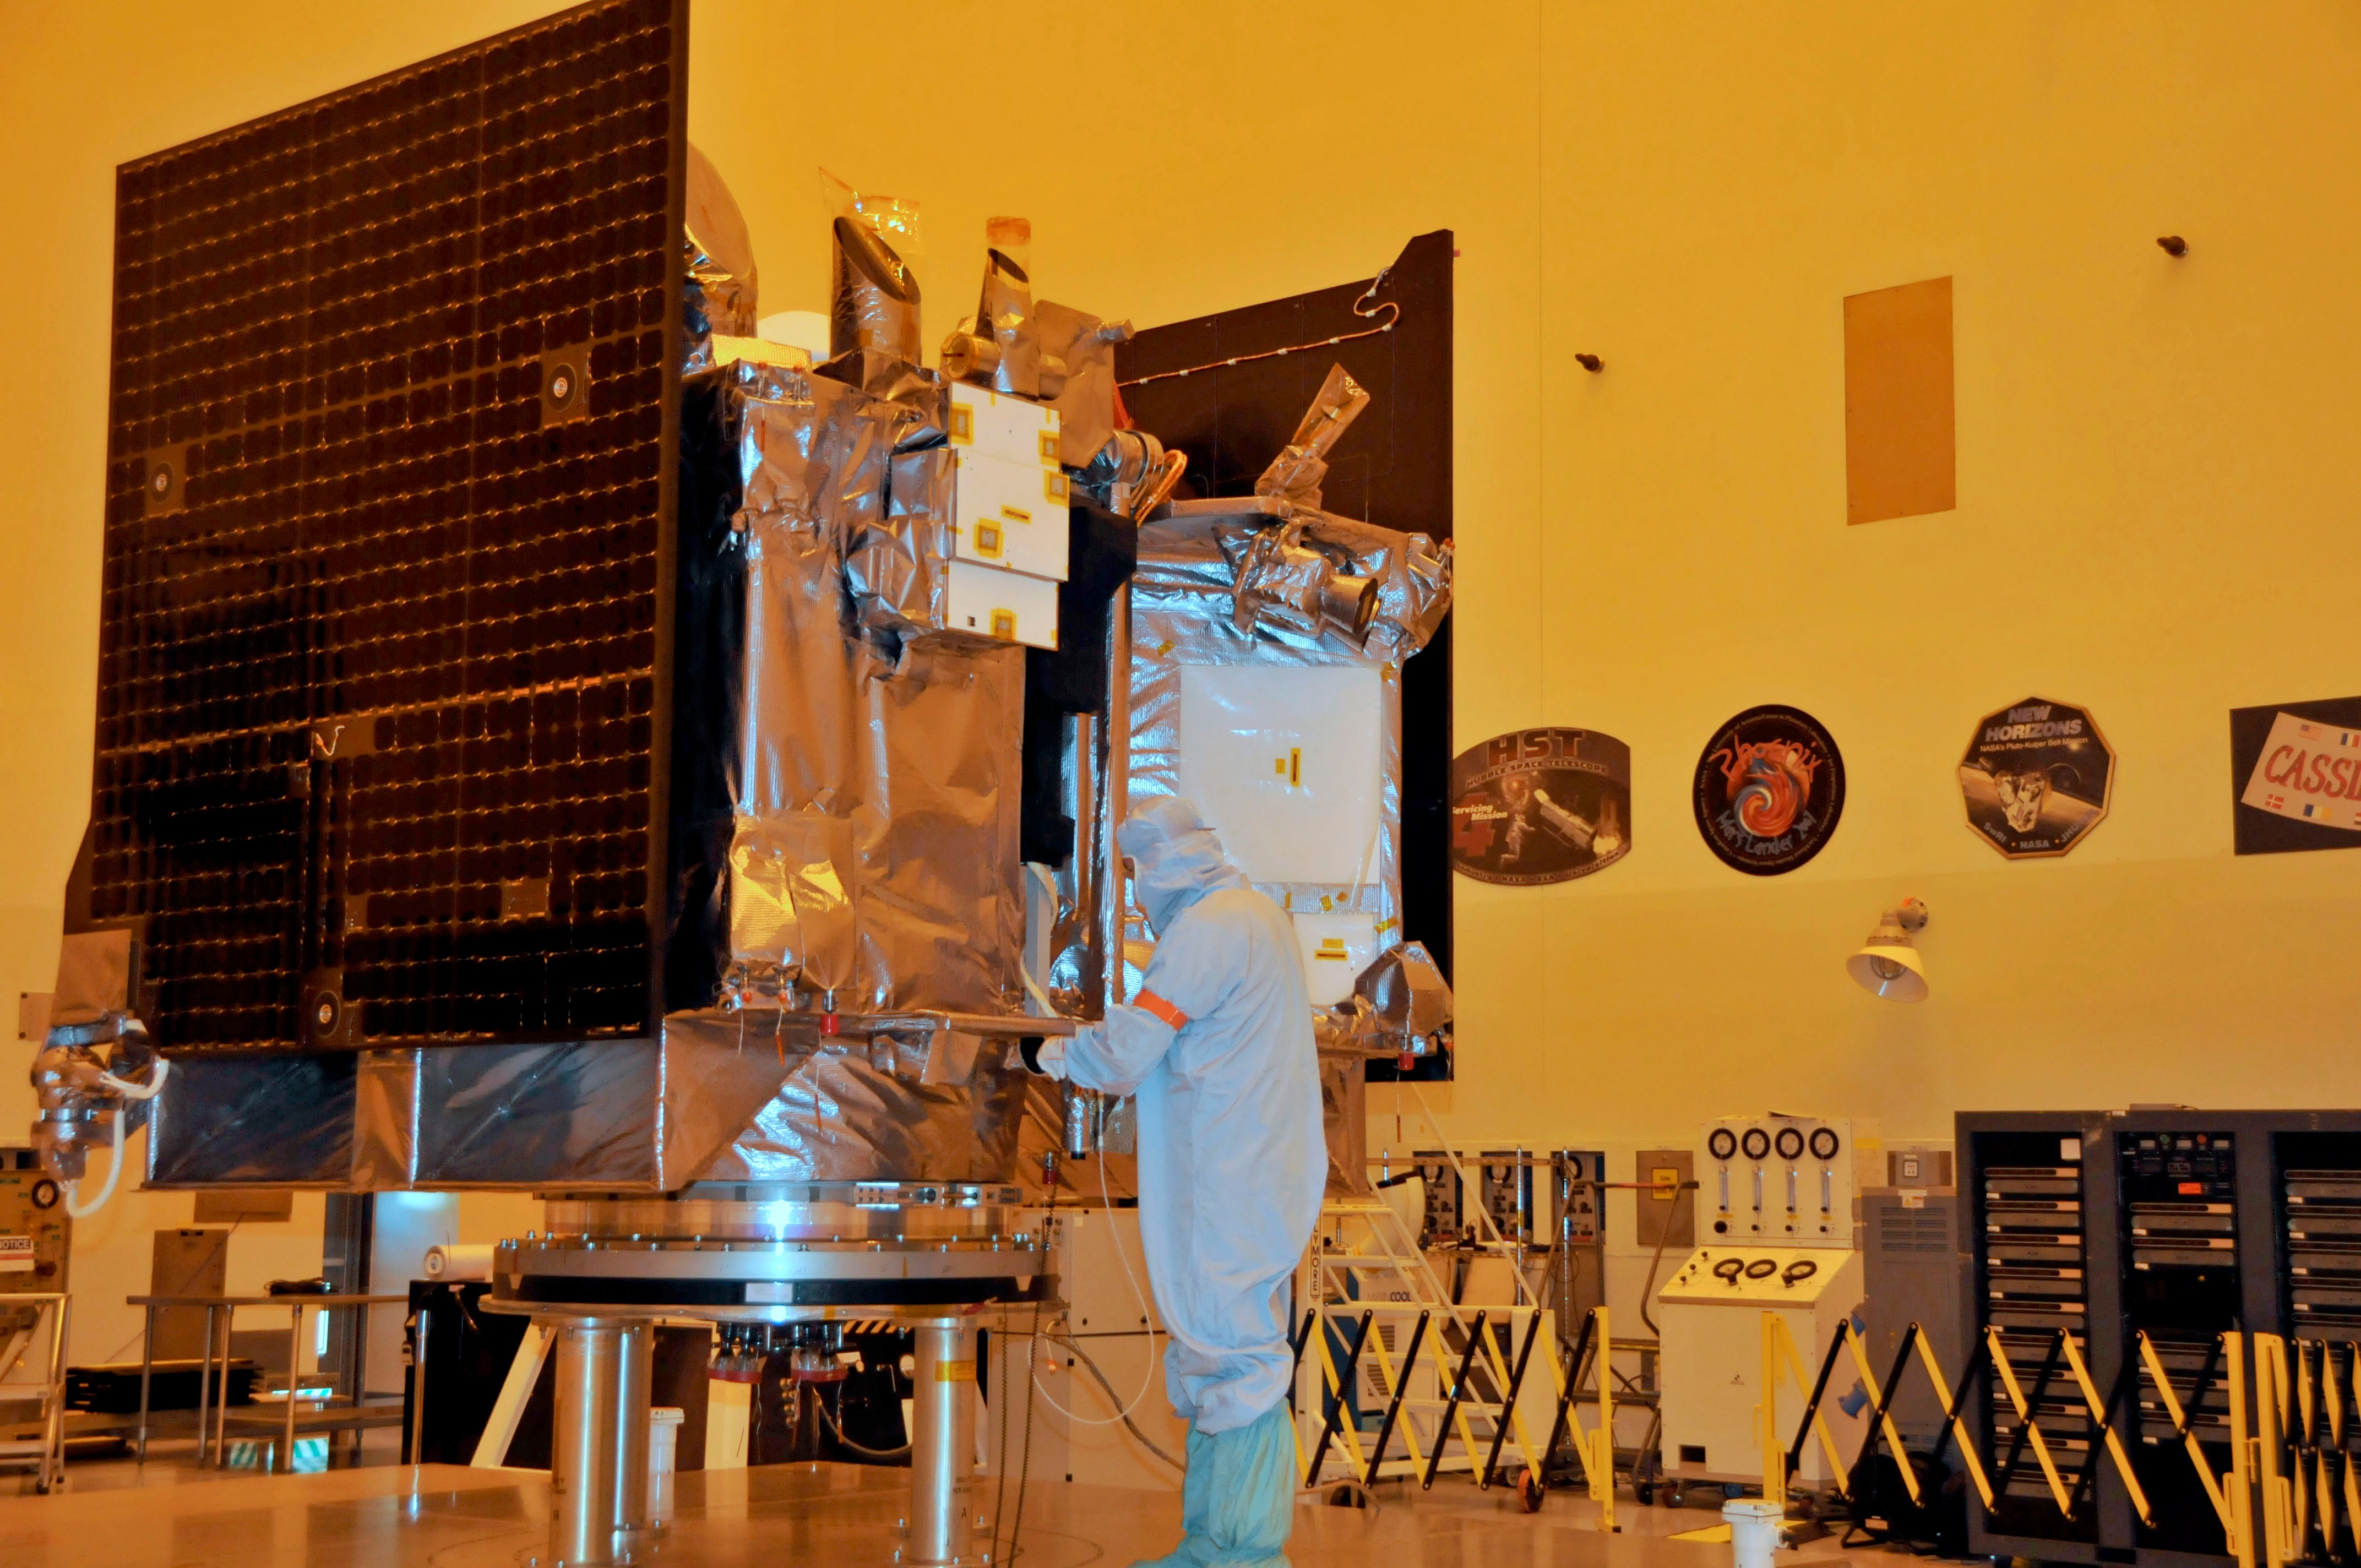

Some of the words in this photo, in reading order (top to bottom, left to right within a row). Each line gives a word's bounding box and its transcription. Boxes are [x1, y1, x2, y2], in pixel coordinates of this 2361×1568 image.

[2008, 706, 2051, 723] NEW
[1985, 719, 2082, 742] HORIZONS
[1487, 728, 1584, 767] HST
[1980, 744, 2005, 752] NASA's
[2006, 741, 2046, 750] Pluto-Kuiper
[1709, 734, 1823, 783] Phoenix
[1466, 767, 1506, 787] HUBBLE
[1510, 760, 1544, 772] SPACE
[1548, 759, 1608, 774] TELESCOPE
[2264, 744, 2361, 801] CASSI
[1471, 810, 1509, 821] Mission
[1716, 810, 1745, 848] Mars
[1745, 834, 1793, 855] Lander
[1983, 821, 2007, 843] SwRI
[2020, 840, 2050, 850] NASA
